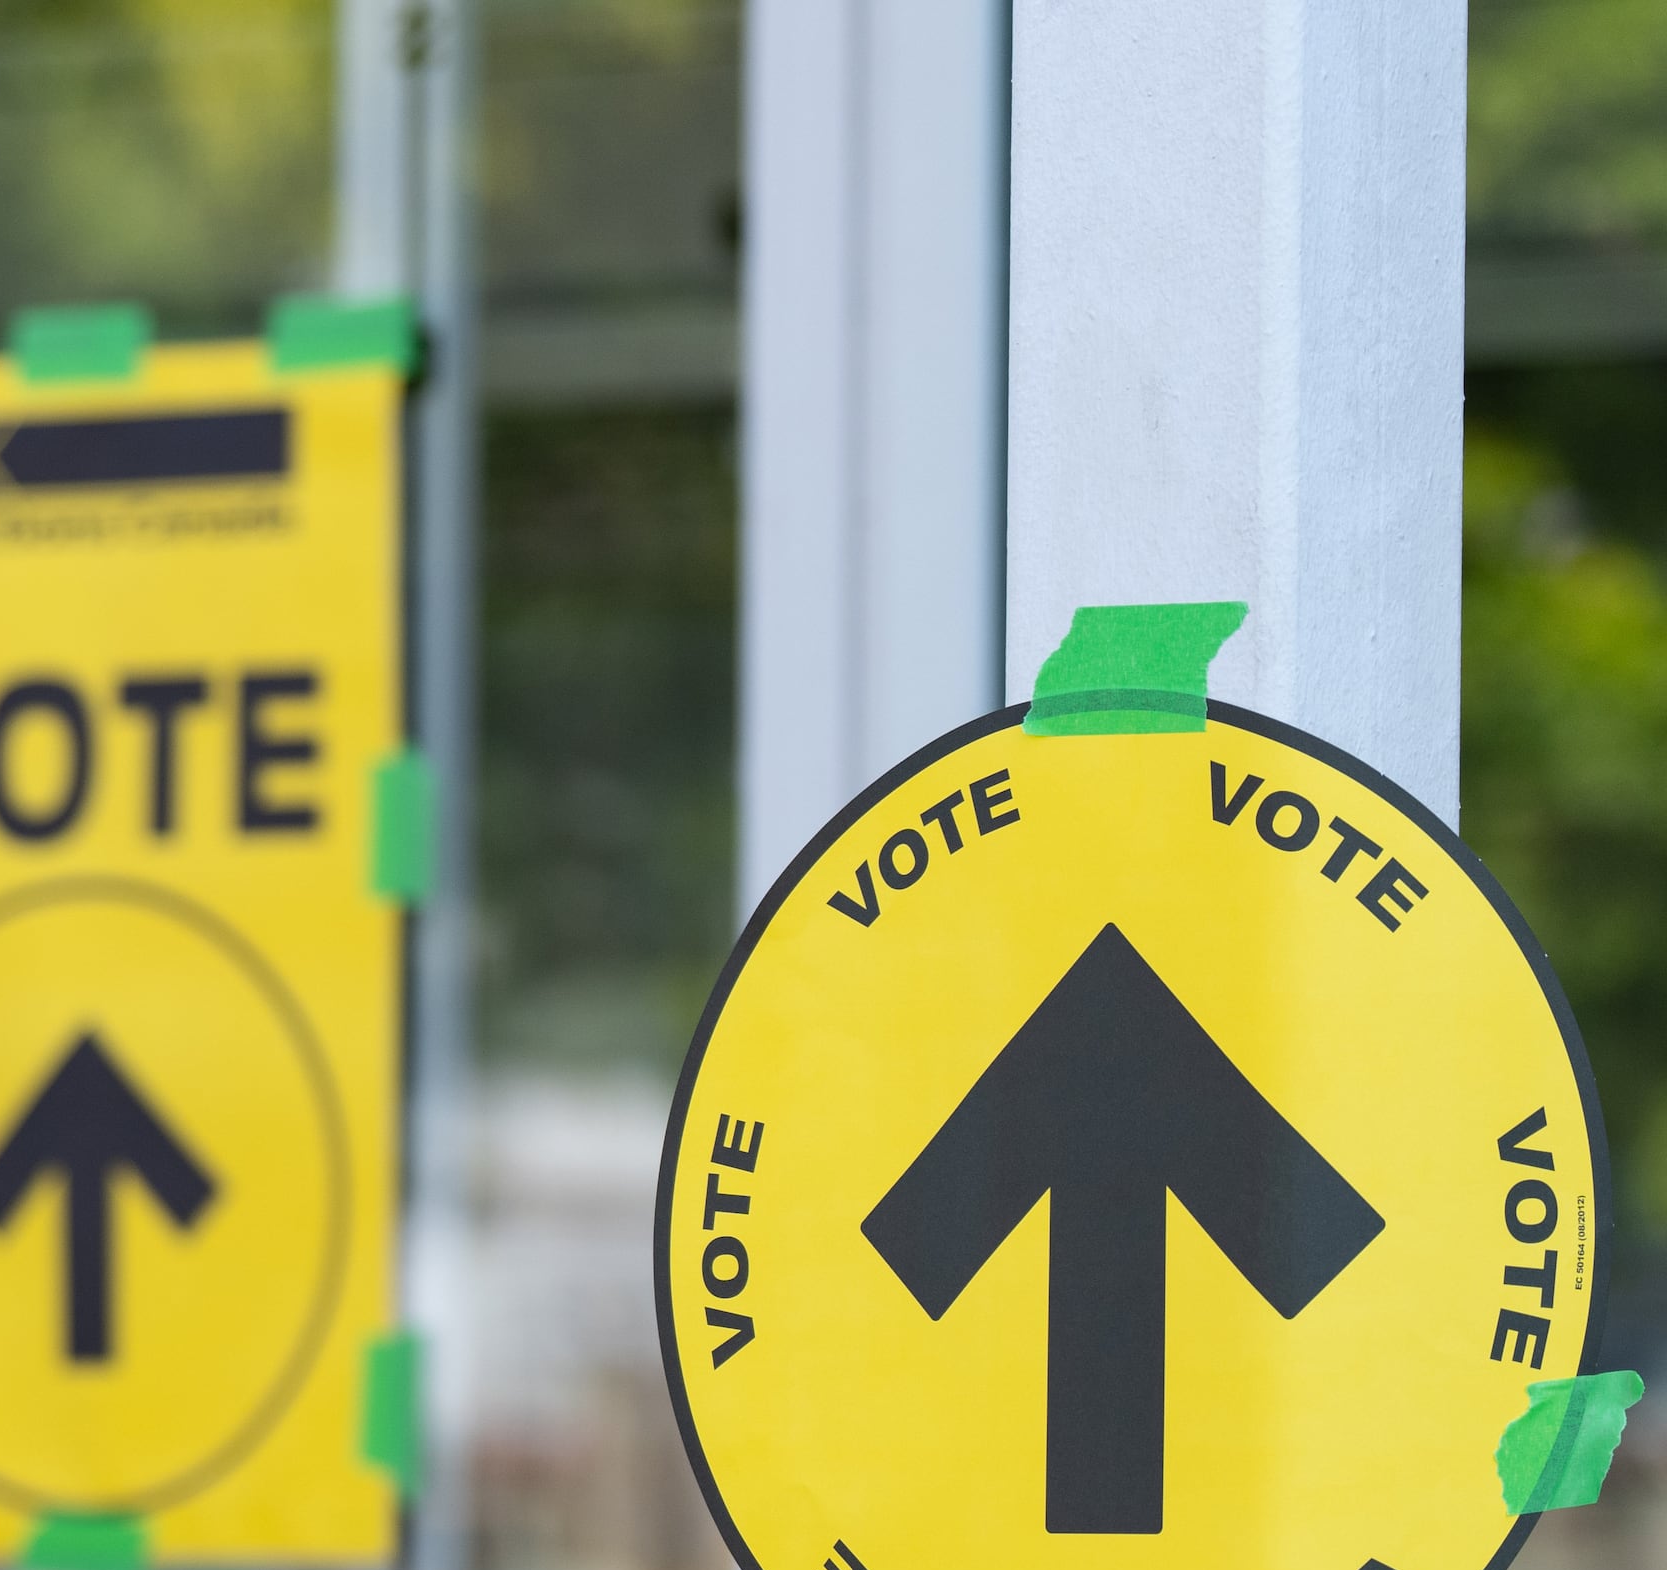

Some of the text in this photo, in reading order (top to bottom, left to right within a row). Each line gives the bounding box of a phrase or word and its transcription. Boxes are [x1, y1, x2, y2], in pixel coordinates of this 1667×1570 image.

[827, 767, 1022, 928] VOTE
[1208, 759, 1430, 933] VOTE
[701, 1112, 766, 1370] VOTE
[1489, 1106, 1559, 1371] VOTE
[1575, 1195, 1587, 1290] EC 50164 (08/2012)
